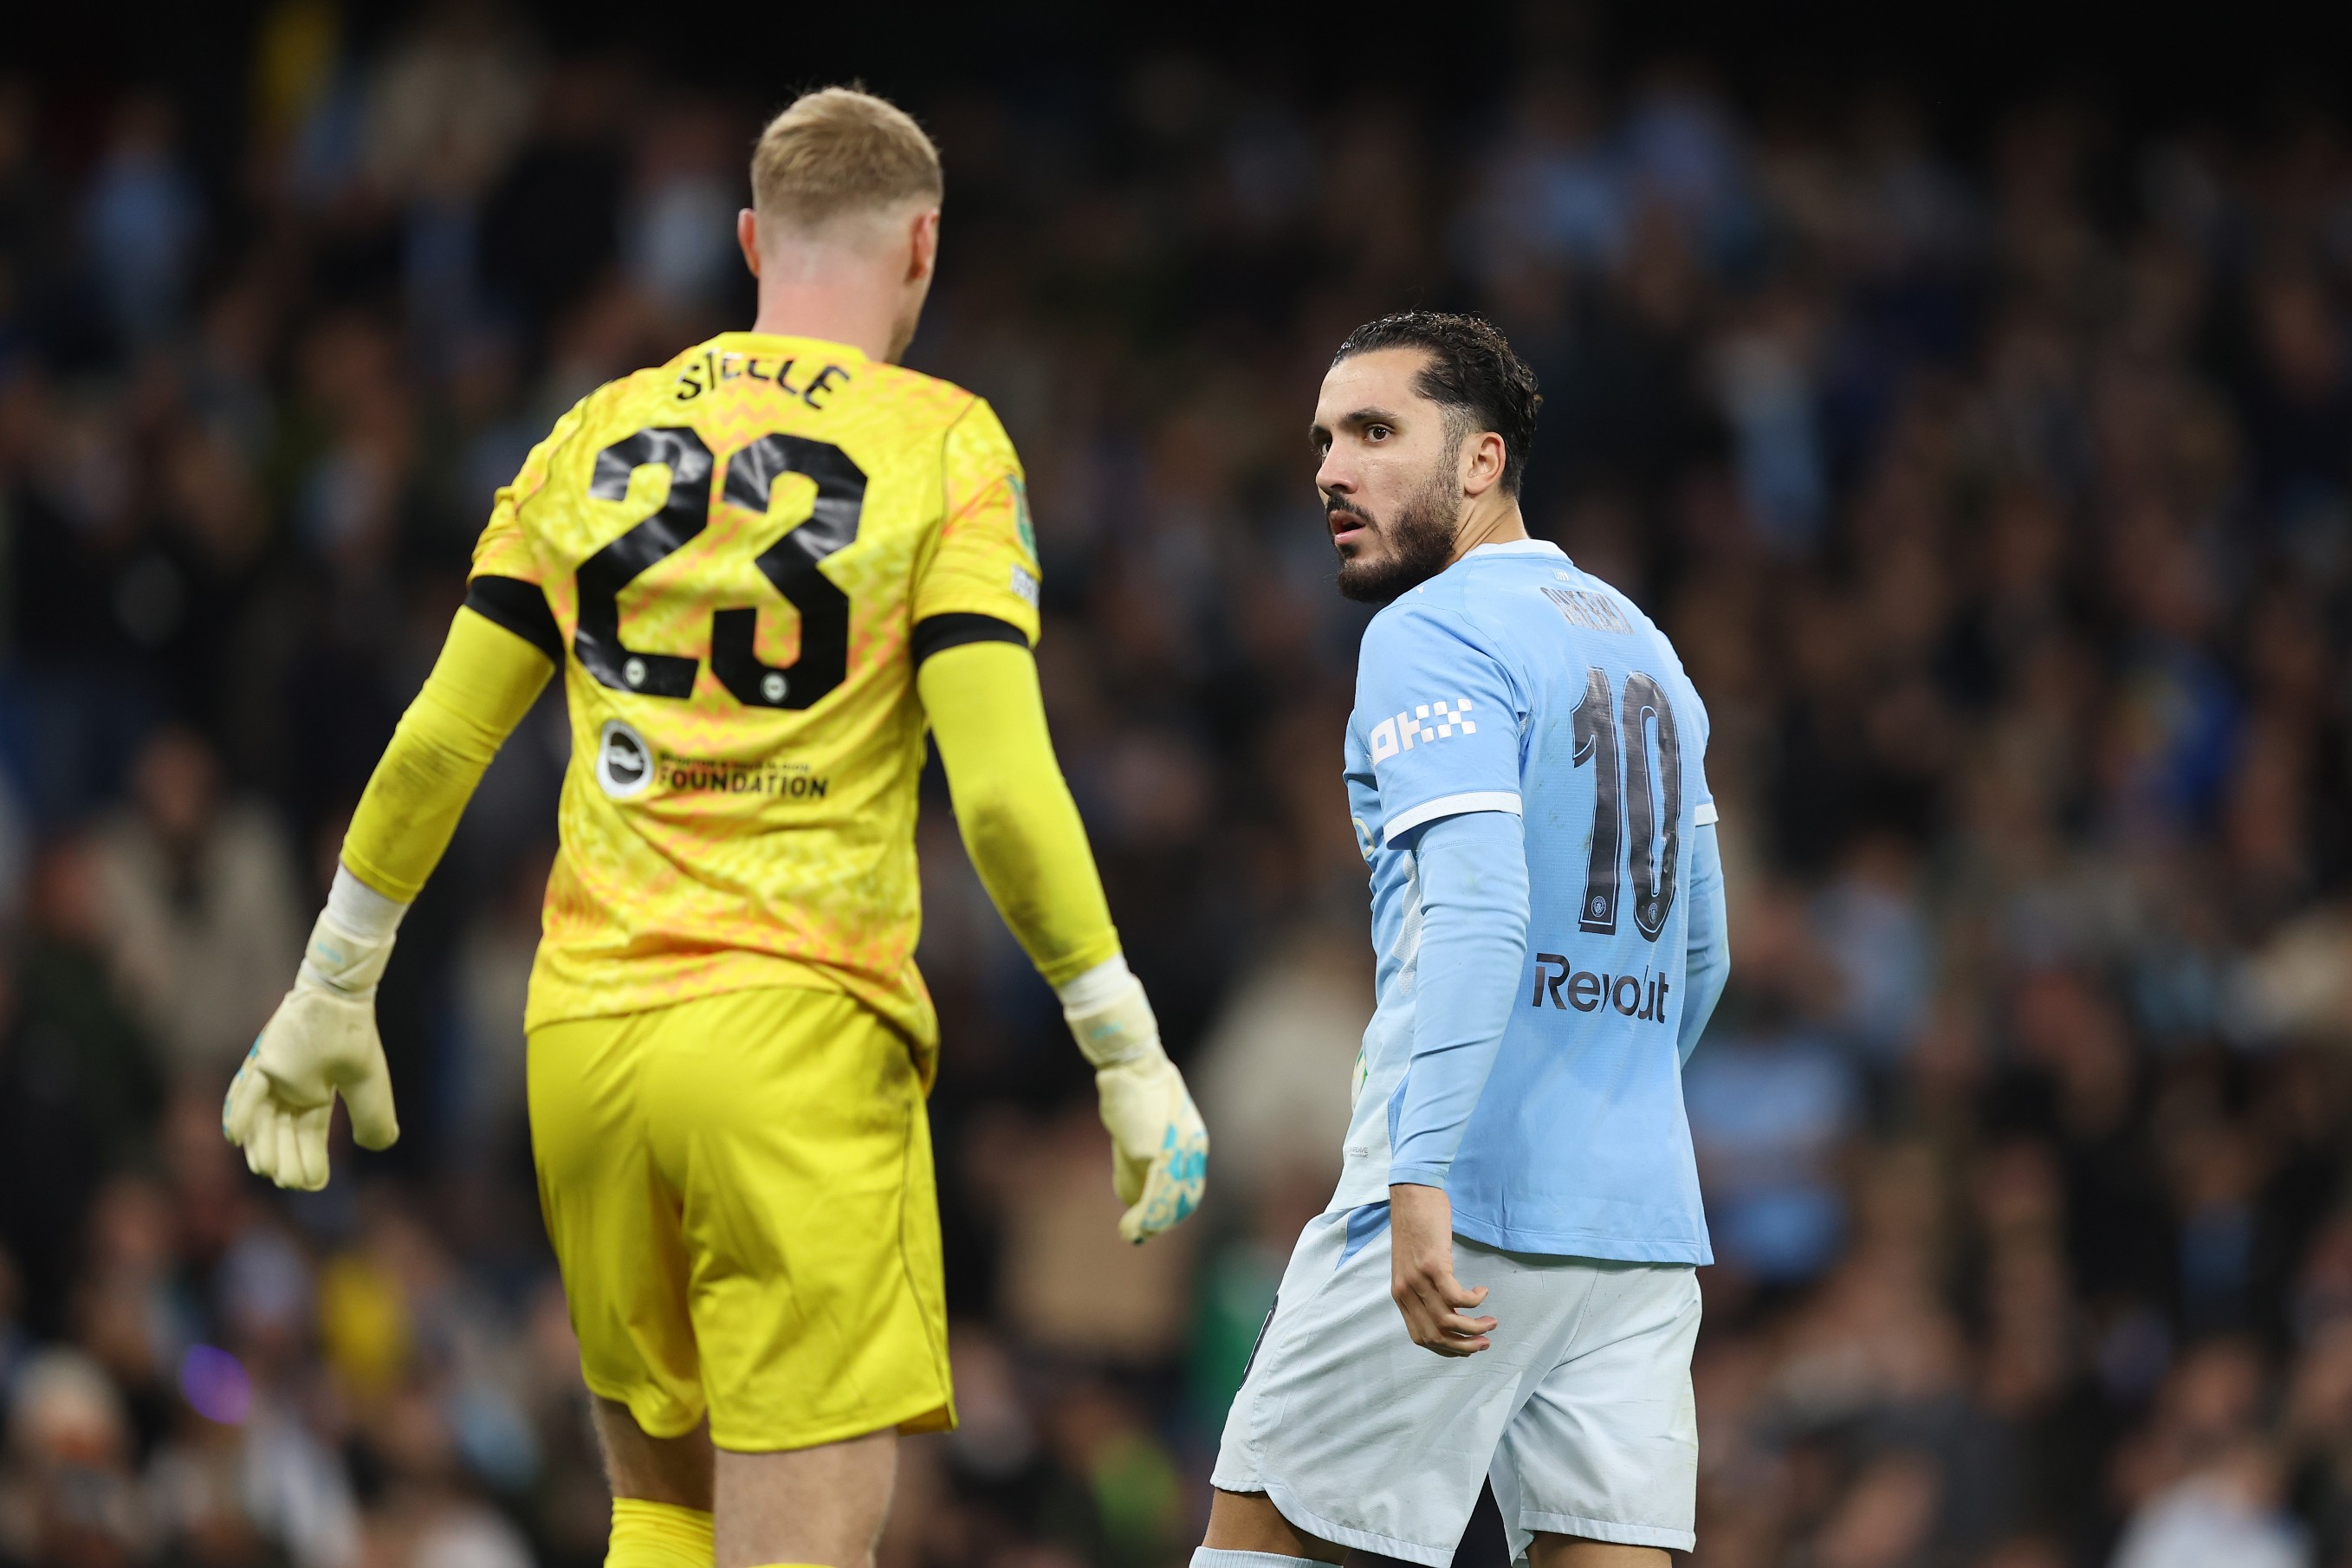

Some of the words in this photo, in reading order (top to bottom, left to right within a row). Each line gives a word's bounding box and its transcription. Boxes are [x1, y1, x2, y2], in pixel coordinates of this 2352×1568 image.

[573, 426, 868, 710] 23
[1370, 698, 1477, 767] OKX
[1571, 665, 1682, 943] 10
